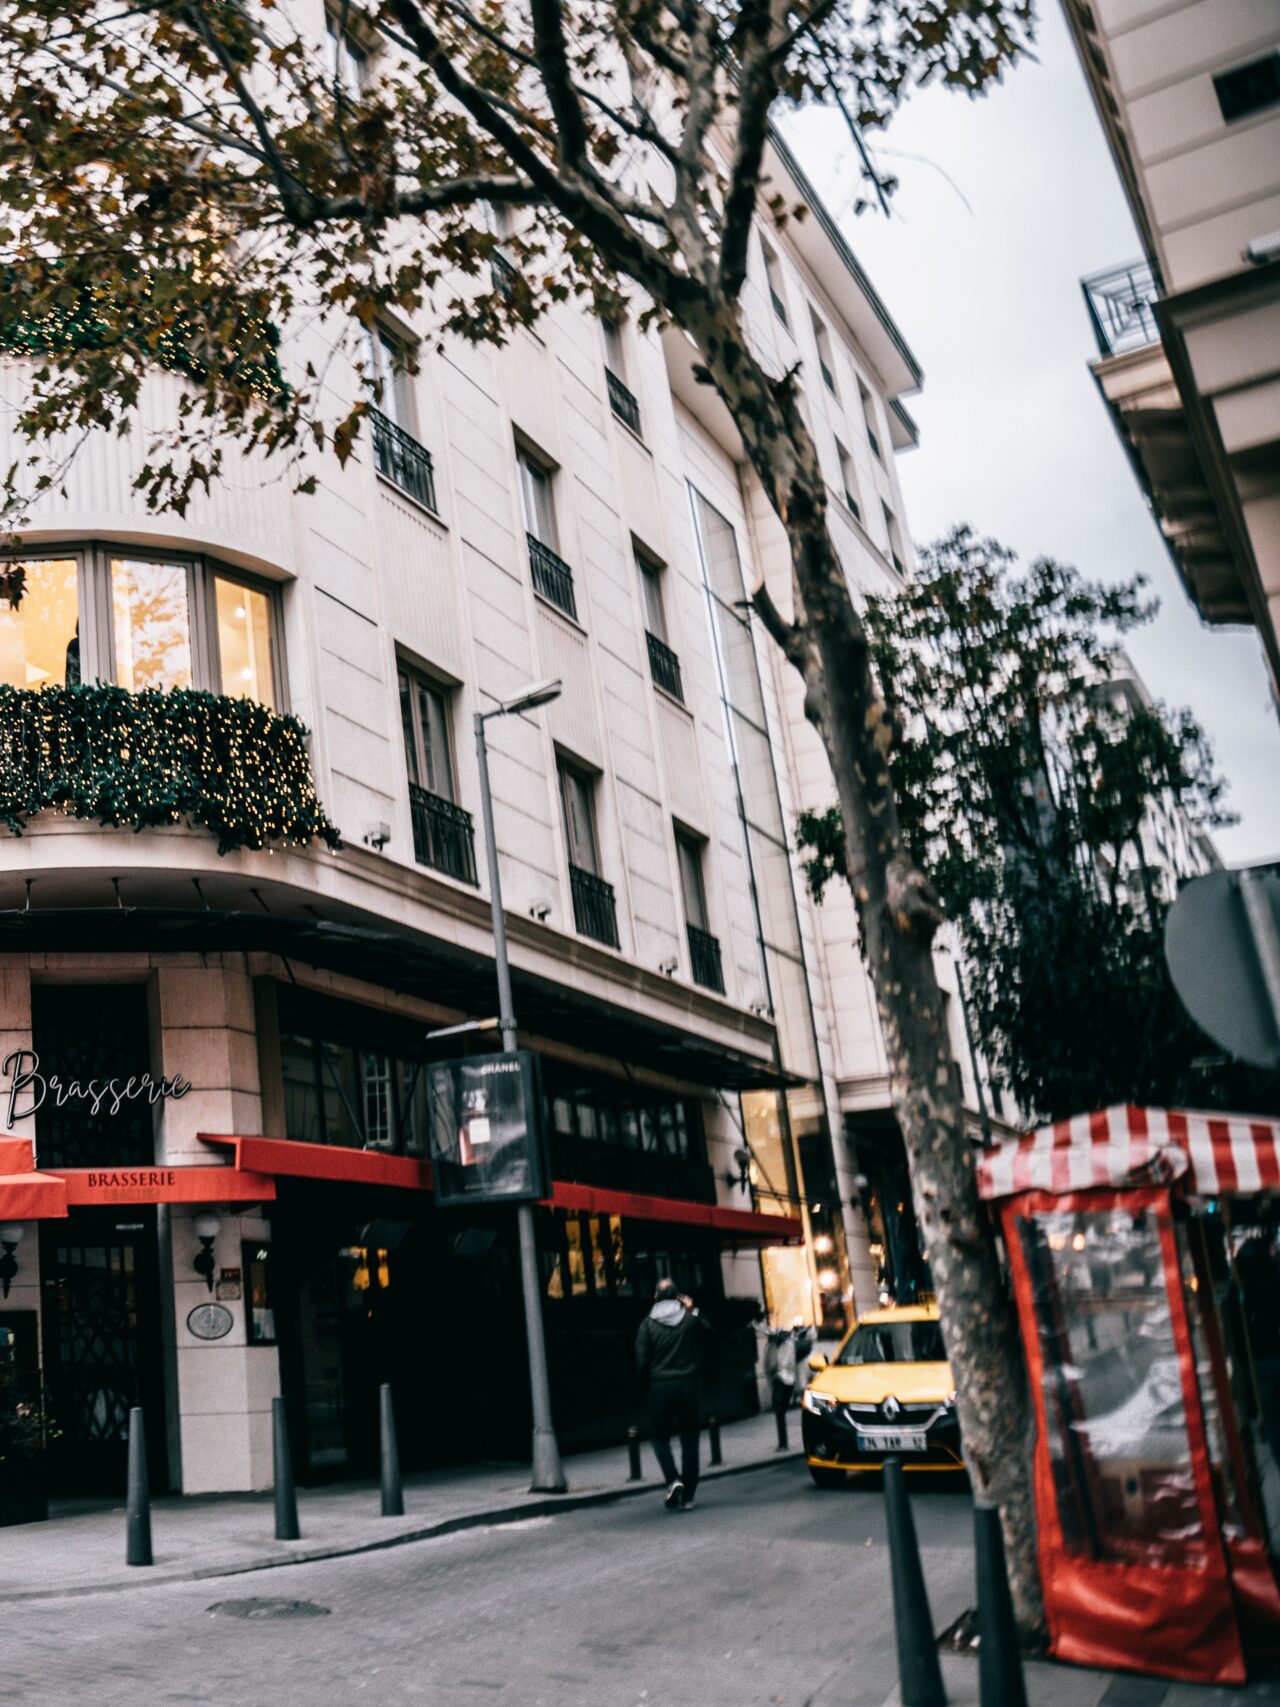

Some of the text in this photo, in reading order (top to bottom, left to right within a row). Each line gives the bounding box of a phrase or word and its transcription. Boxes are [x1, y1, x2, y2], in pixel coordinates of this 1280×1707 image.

[481, 1061, 521, 1075] CHANEL
[2, 1048, 192, 1130] Brasserie
[87, 1171, 176, 1188] BRASSERIE
